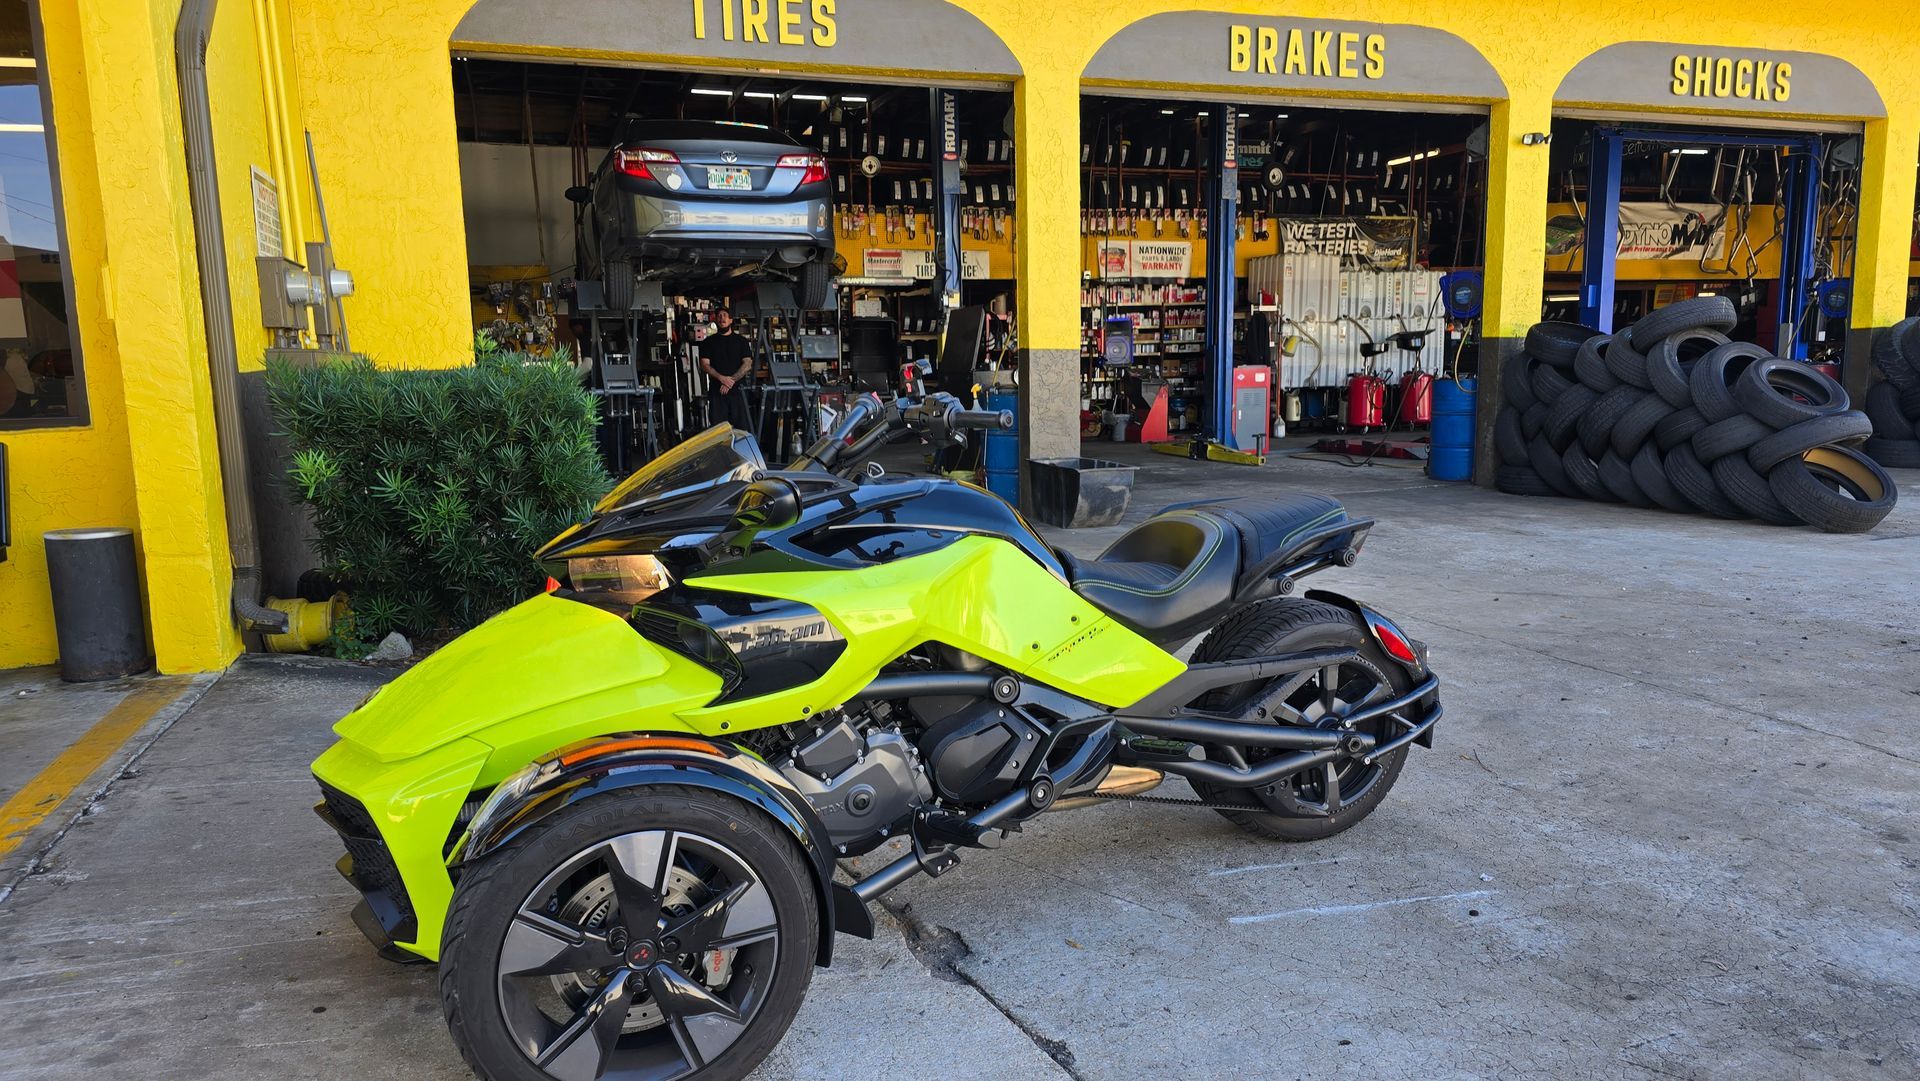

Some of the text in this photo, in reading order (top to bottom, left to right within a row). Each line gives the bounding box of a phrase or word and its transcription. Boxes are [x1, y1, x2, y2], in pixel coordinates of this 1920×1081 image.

[693, 0, 838, 47] TIRES
[1229, 24, 1386, 79] BRAKES
[1672, 55, 1792, 102] SHOCKS
[944, 92, 956, 152] ROTARY
[1225, 105, 1236, 160] ROTARY
[1238, 140, 1271, 155] mmit
[1237, 155, 1264, 167] ires
[1286, 222, 1357, 240] WE TEST
[1138, 246, 1187, 256] NATIONWIDE
[915, 264, 935, 278] TIRE
[1142, 262, 1183, 271] WARRANTY
